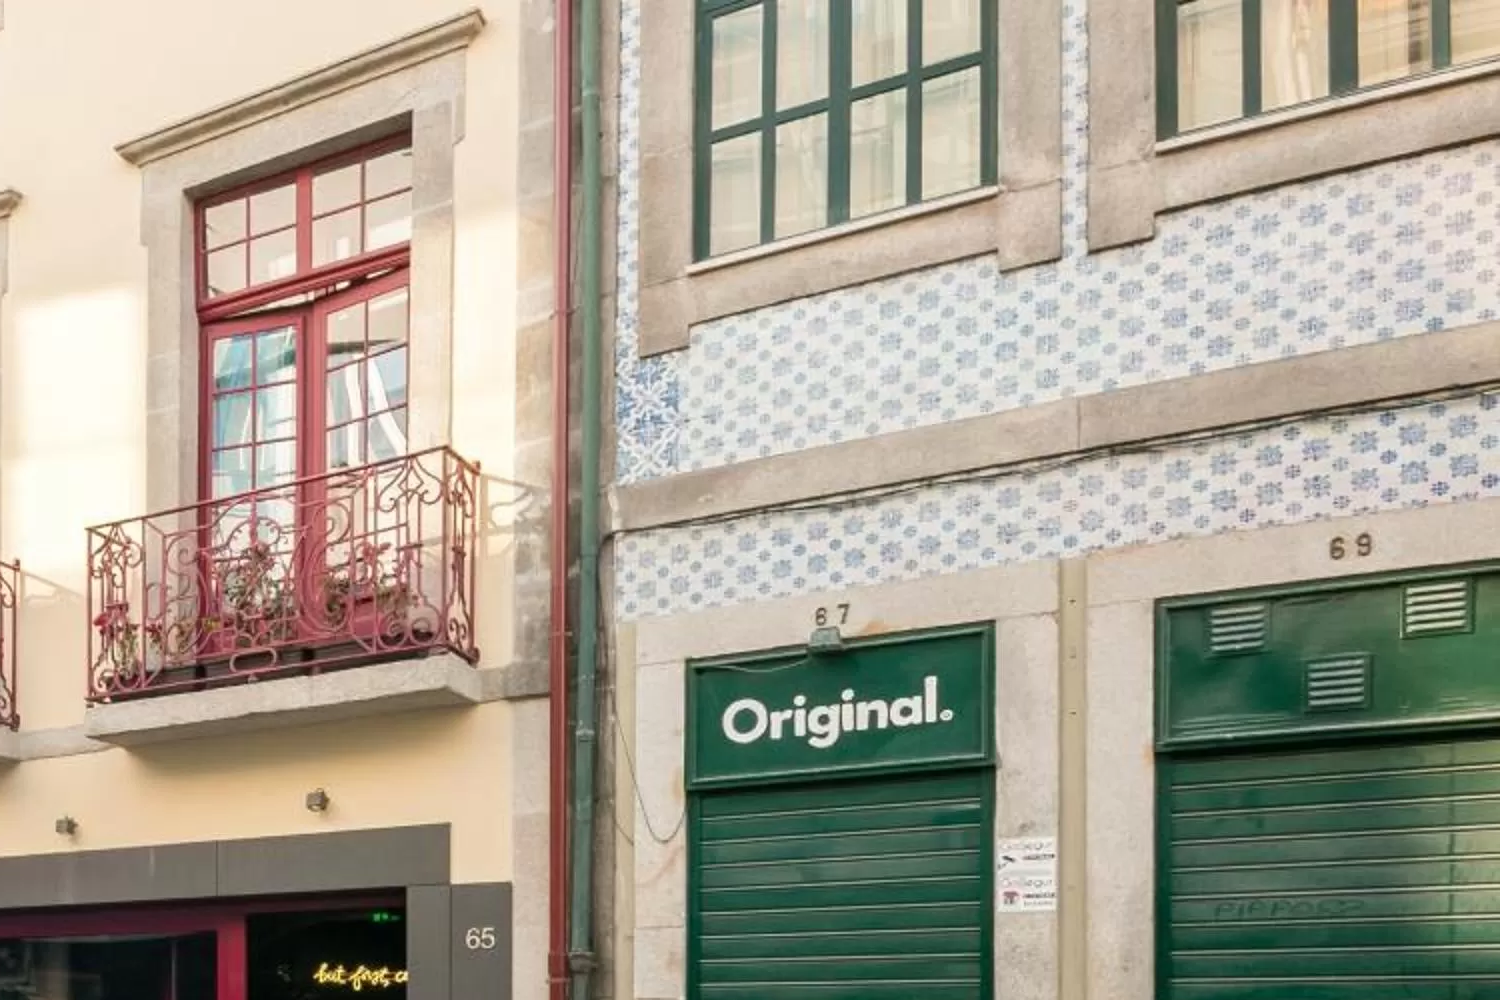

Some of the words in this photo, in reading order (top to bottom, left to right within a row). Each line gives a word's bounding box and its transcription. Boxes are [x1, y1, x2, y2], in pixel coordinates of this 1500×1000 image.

[1330, 533, 1372, 561] 69
[815, 603, 851, 626] 67
[721, 675, 954, 748] Original.
[464, 927, 496, 950] 65
